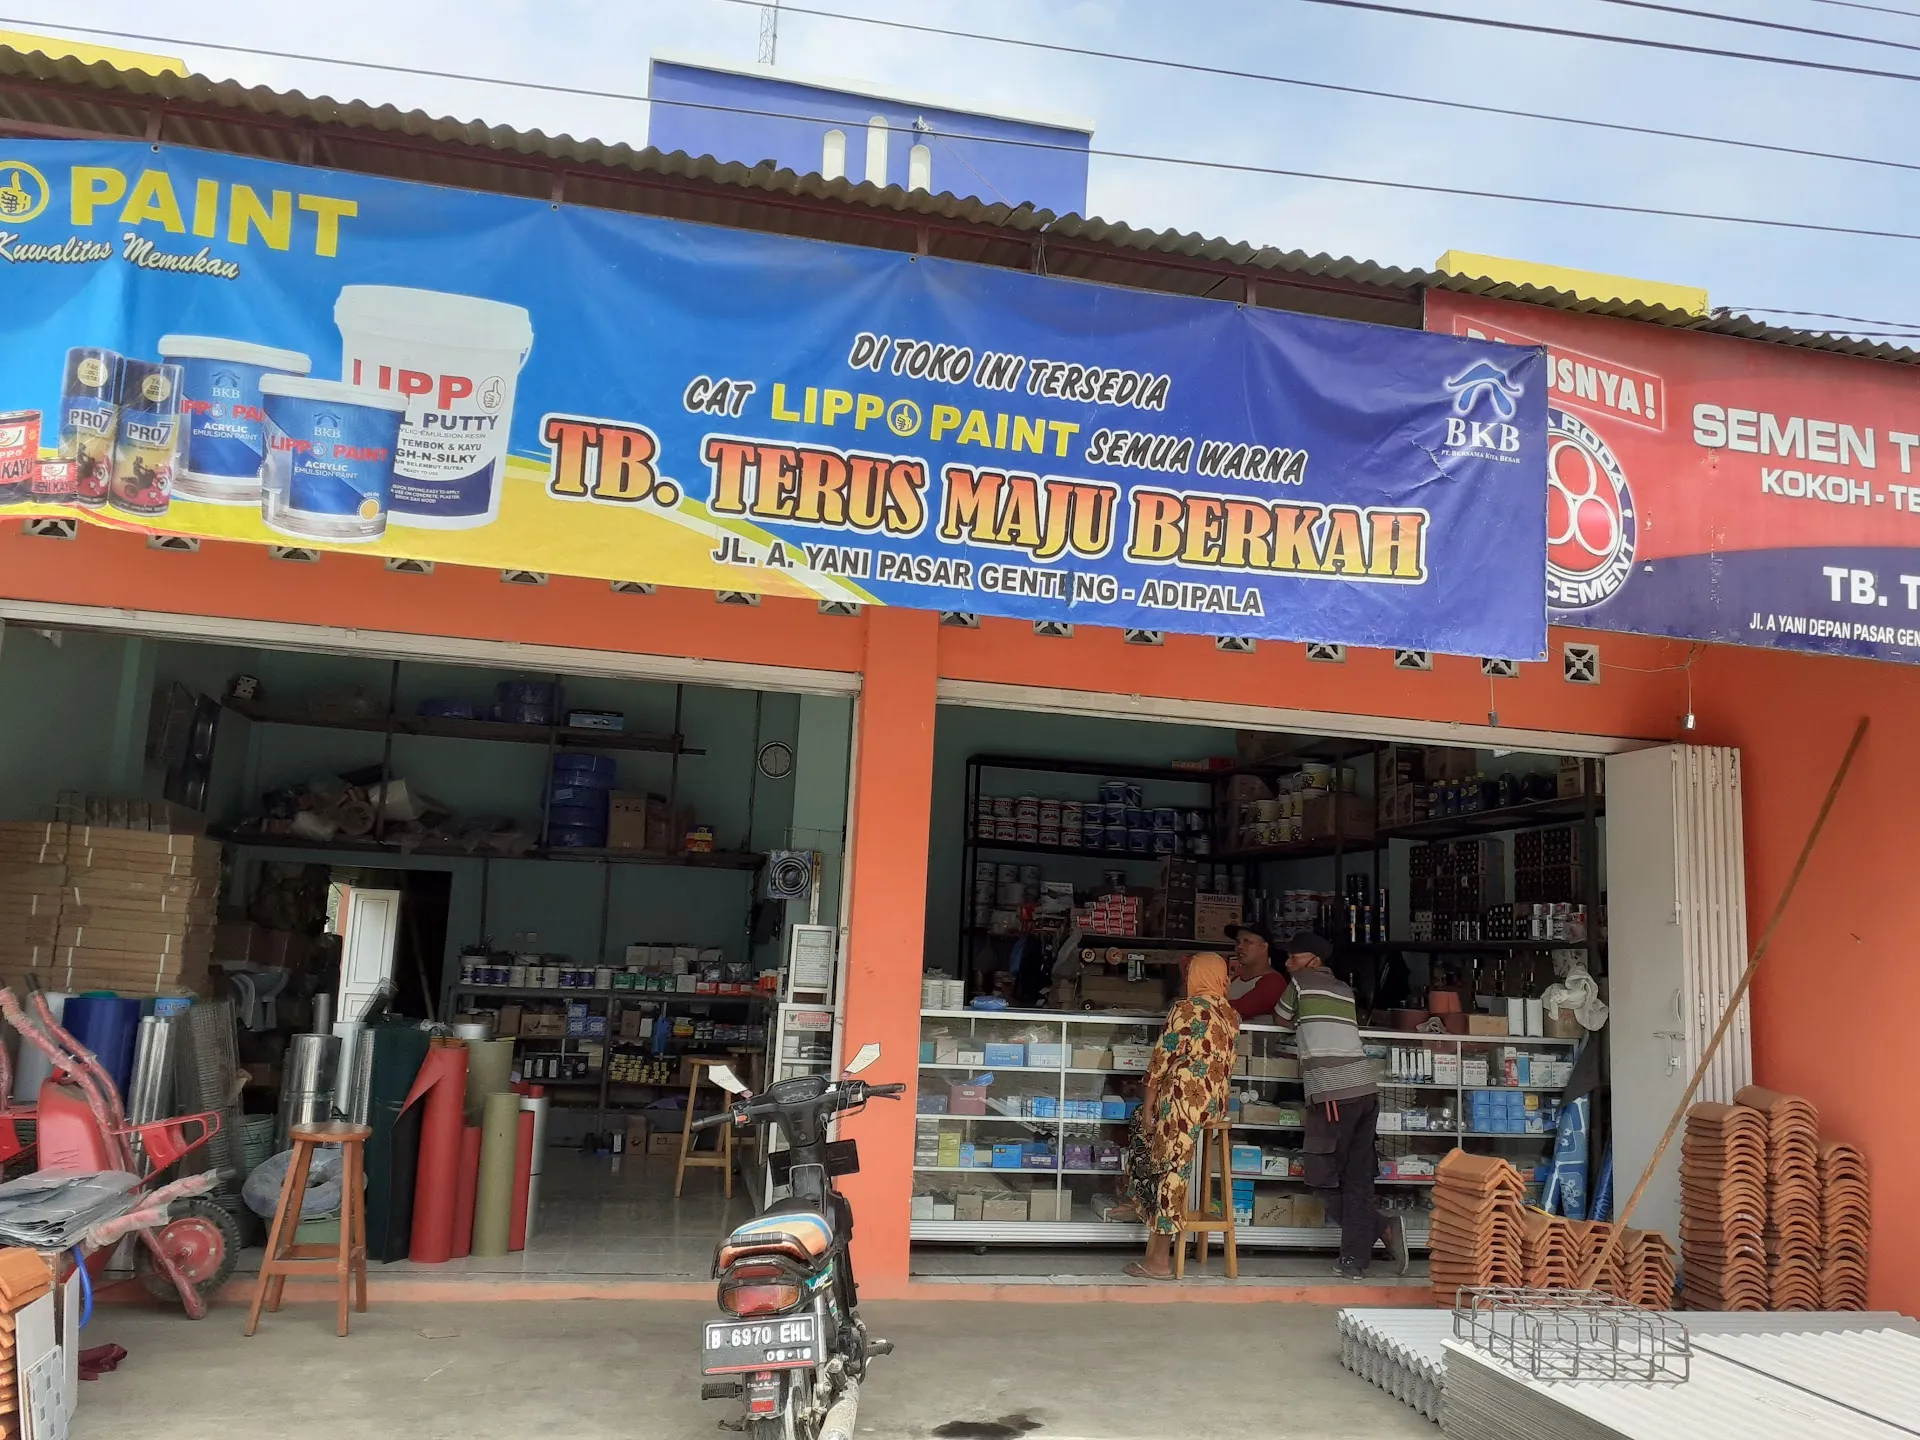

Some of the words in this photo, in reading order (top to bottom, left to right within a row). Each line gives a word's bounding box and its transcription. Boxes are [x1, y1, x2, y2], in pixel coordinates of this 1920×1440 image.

[71, 166, 358, 258] PAINT
[122, 232, 240, 280] Memukau
[850, 335, 889, 370] DI
[892, 341, 972, 382] TOKO
[976, 353, 1024, 389] INI
[1028, 362, 1169, 409] TERSEDIA
[212, 387, 240, 399] BKB
[71, 409, 113, 433] PRO7
[128, 423, 174, 445] PRO7
[193, 429, 233, 439] EMULSION
[234, 432, 258, 441] PAINT
[204, 422, 249, 434] ACRYLIC
[313, 427, 341, 439] BKB
[423, 412, 499, 431] PUTTY
[685, 377, 753, 416] CAT
[930, 404, 1080, 457] PAINT
[1088, 431, 1192, 471] SEMUA
[1199, 442, 1307, 483] WARNA
[1444, 418, 1520, 452] BKB
[1693, 404, 1876, 469] SEMEN
[333, 445, 389, 462] PAINT
[401, 438, 445, 451] TEMBOK
[1561, 413, 1625, 495] RODA
[294, 466, 335, 477] EMULSION
[335, 470, 359, 479] PAINT
[305, 460, 349, 472] ACRYLIC
[545, 418, 681, 508] TB.
[1761, 467, 1871, 506] KOKOH
[706, 437, 926, 534] TERUS
[943, 466, 1117, 558] MAJU
[1128, 490, 1427, 580] BERKAH
[713, 537, 756, 565] JL.
[766, 542, 794, 568] A.
[805, 546, 869, 576] YANI
[880, 553, 974, 588] PASAR
[1141, 582, 1262, 614] ADIPALA
[1823, 566, 1888, 607] TB.
[1766, 614, 1776, 631] A
[1778, 615, 1807, 634] YANI
[1809, 618, 1851, 640] DEPAN
[1853, 623, 1895, 645] PASAR
[711, 1329, 721, 1349] B
[731, 1326, 772, 1347] 6970
[780, 1322, 811, 1343] EHL
